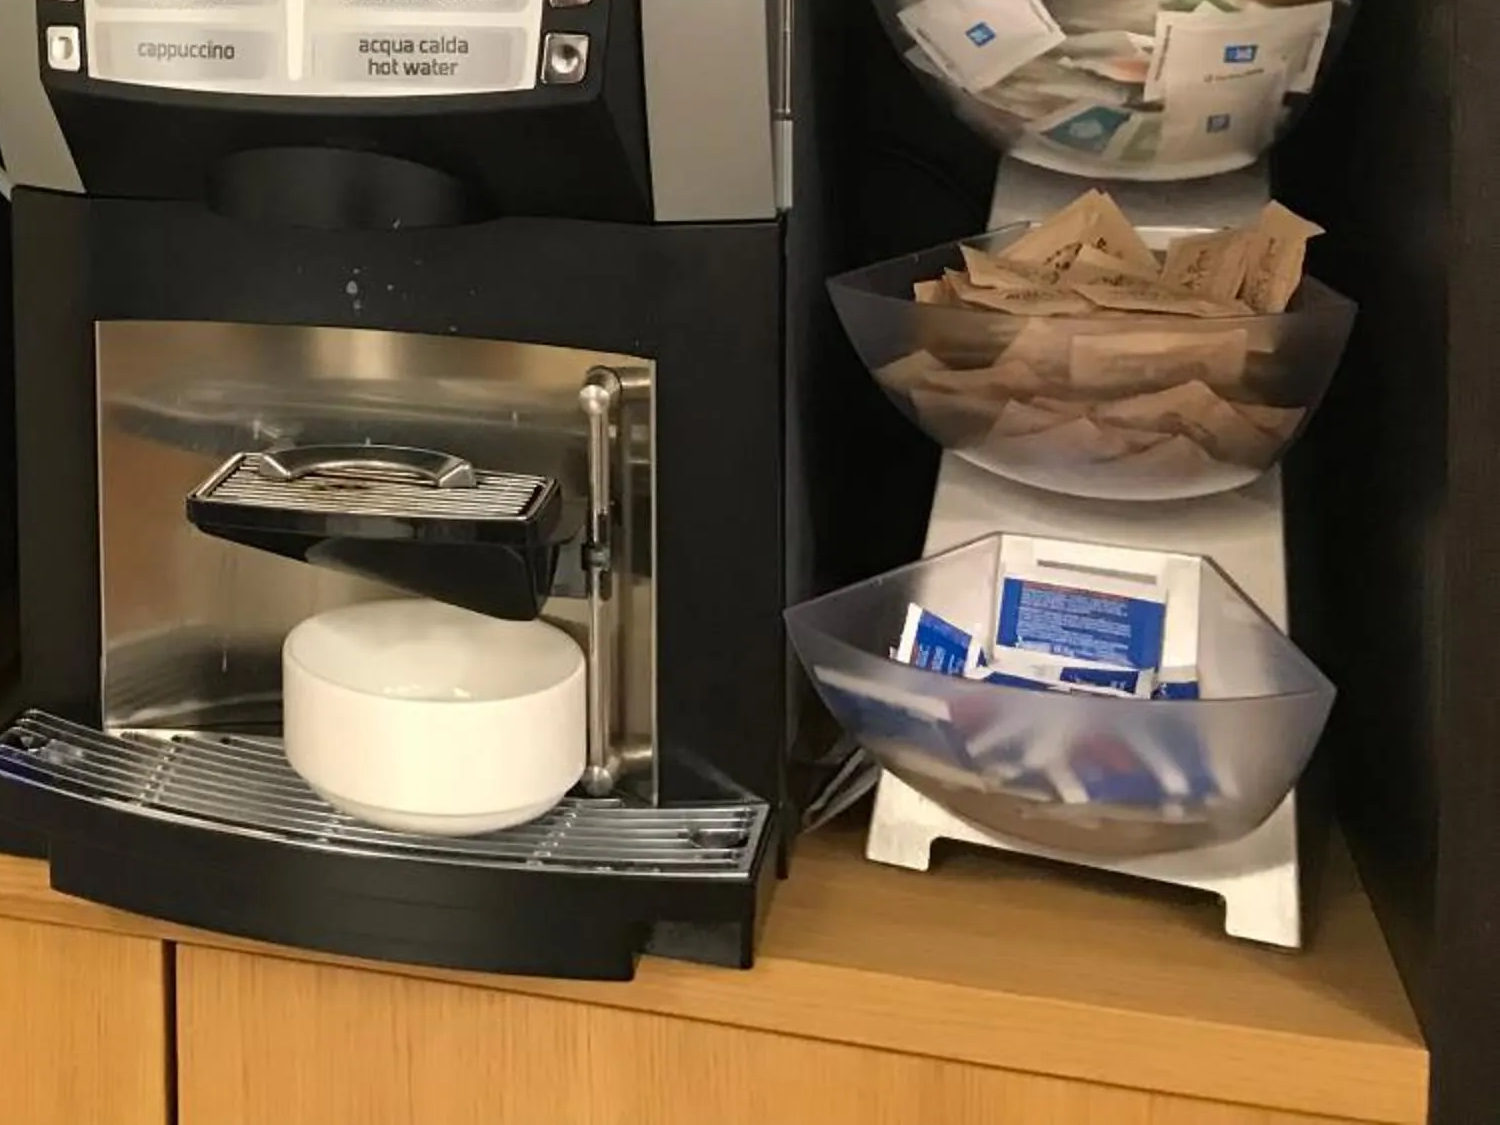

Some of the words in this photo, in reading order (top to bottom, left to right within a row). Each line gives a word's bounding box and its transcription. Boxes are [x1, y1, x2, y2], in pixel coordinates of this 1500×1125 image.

[137, 41, 235, 61] cappuccino
[359, 38, 414, 57] acqua
[419, 36, 469, 54] calda
[368, 58, 399, 76] hot
[403, 58, 459, 76] water
